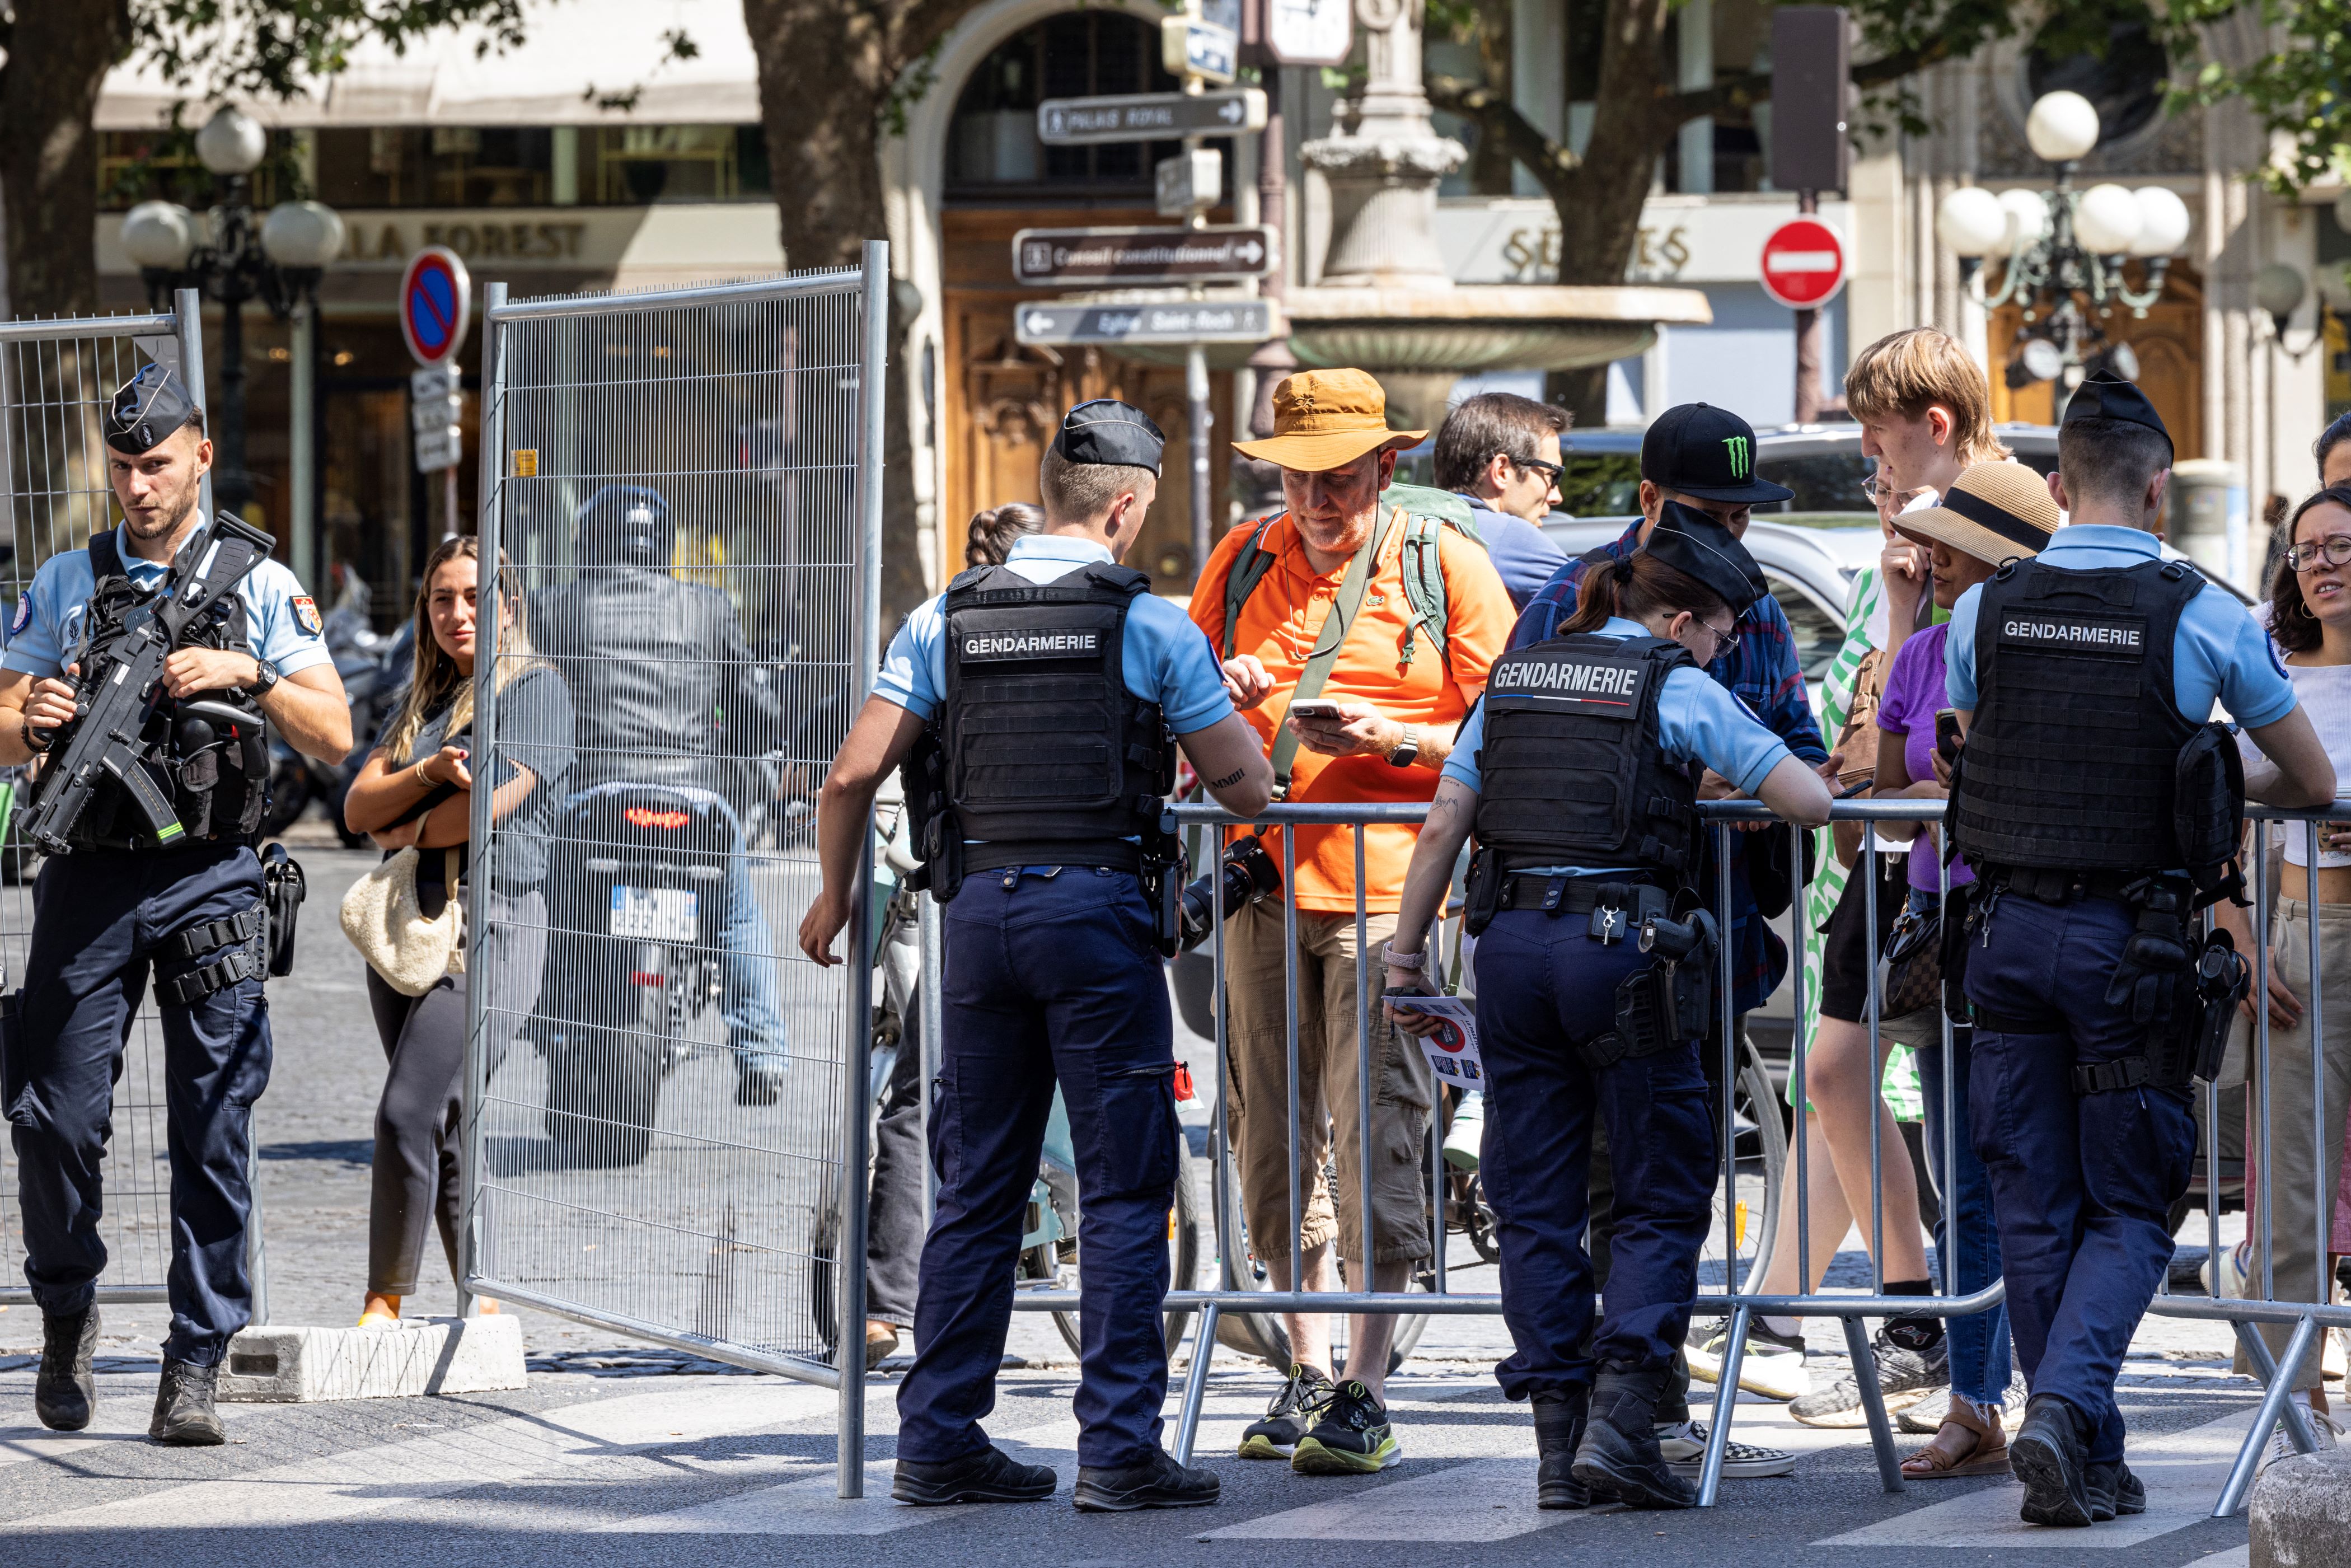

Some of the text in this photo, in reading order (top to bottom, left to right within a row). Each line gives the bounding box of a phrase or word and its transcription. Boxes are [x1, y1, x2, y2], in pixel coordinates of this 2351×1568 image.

[966, 635, 1096, 654] GENDARMERIE
[2005, 621, 2140, 645] GENDARMERIE
[1495, 662, 1638, 696] GENDARMERIE
